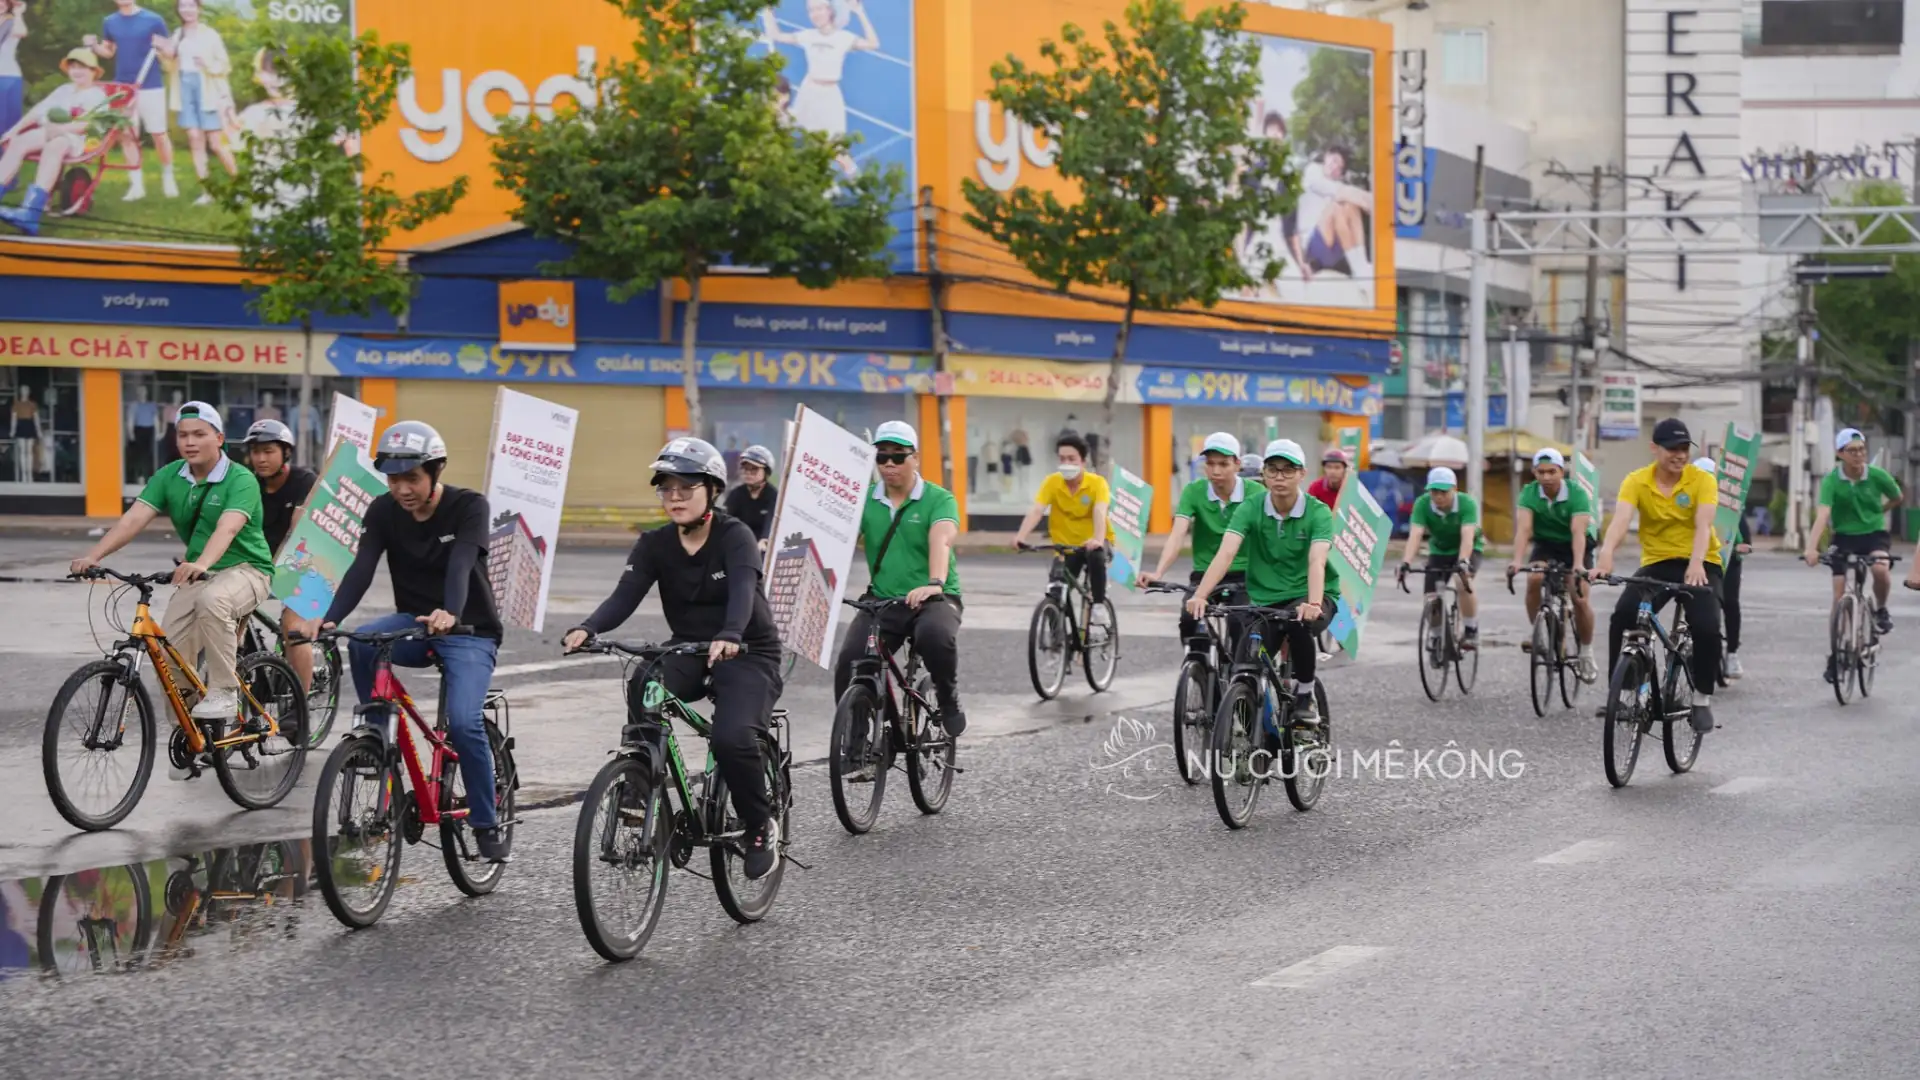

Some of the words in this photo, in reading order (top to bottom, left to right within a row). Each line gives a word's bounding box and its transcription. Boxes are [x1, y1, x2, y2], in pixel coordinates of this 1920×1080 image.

[397, 45, 621, 163] yod
[103, 293, 170, 308] yody.vn
[507, 297, 569, 327] yody
[734, 315, 766, 328] look
[818, 318, 845, 331] feel
[849, 320, 887, 334] good
[732, 350, 837, 386] 149K
[1203, 372, 1249, 402] 99K
